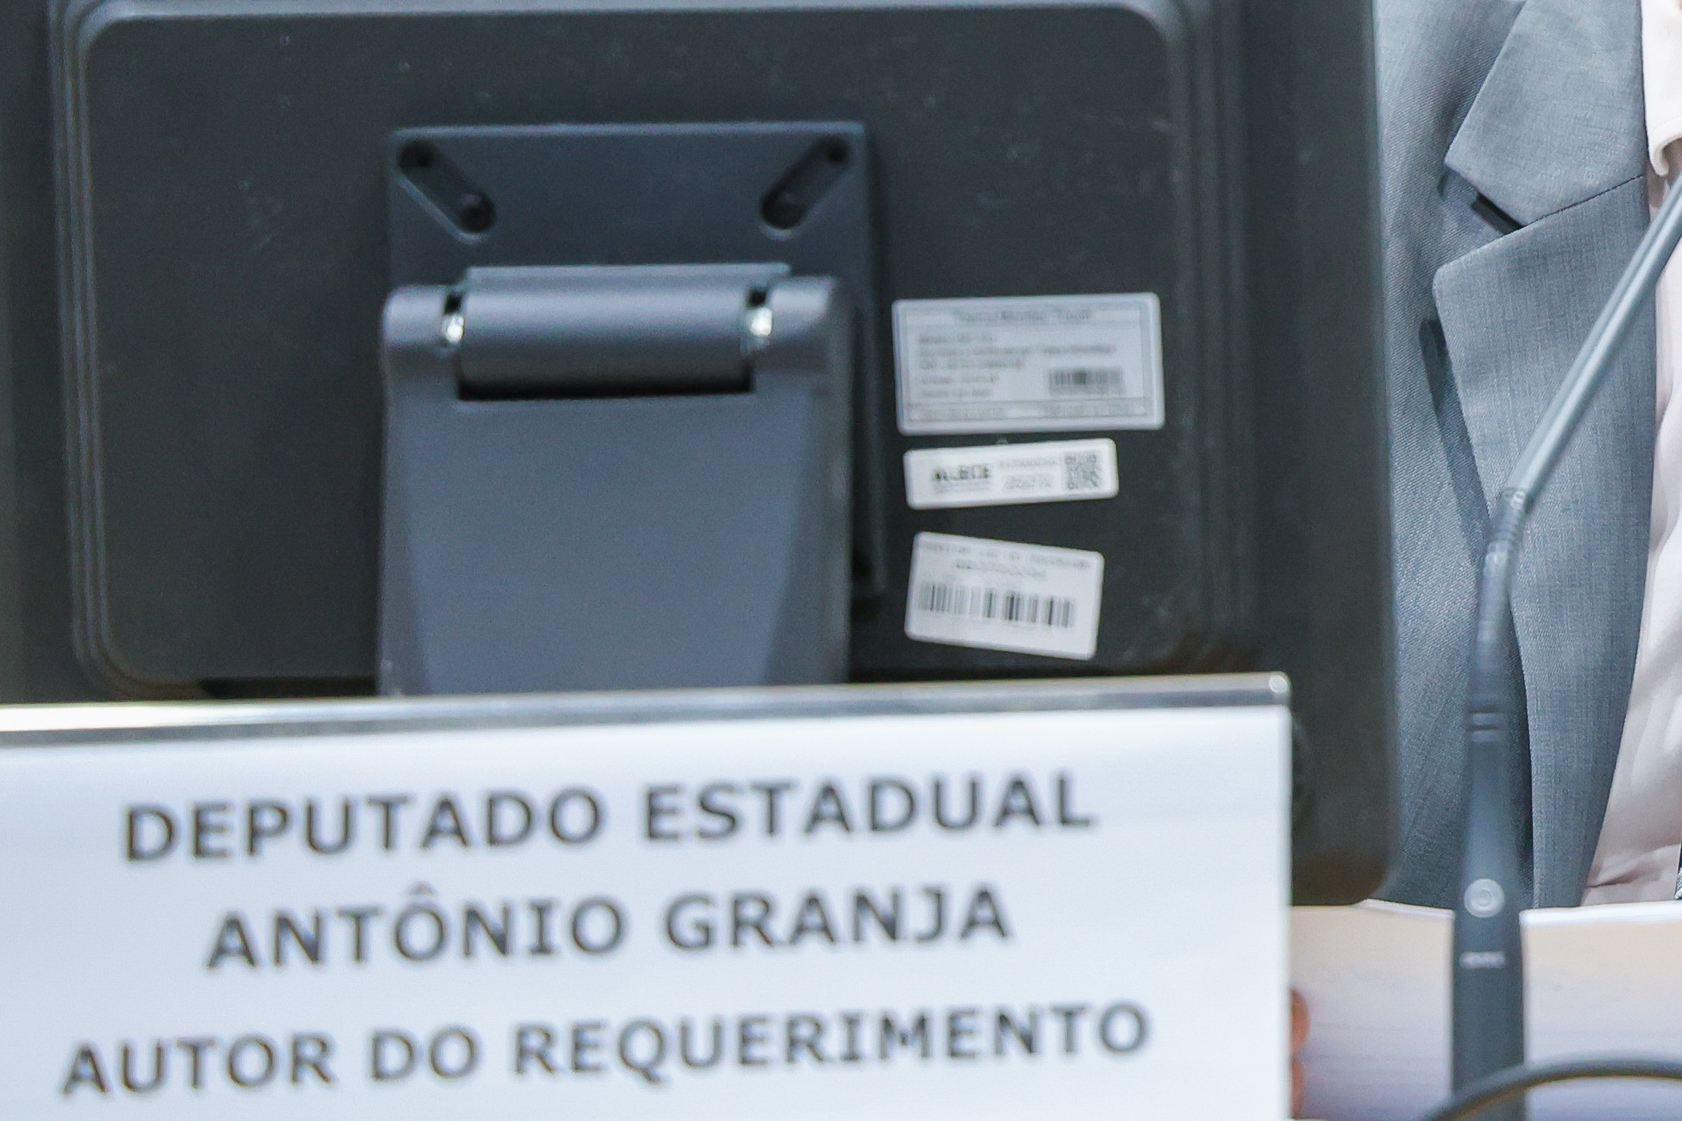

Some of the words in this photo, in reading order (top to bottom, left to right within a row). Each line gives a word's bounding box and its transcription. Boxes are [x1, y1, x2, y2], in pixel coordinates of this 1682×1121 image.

[123, 787, 606, 863] DEPUTADO
[643, 773, 1098, 843] ESTADUAL
[204, 884, 627, 971] ANTÔNIO
[662, 884, 1014, 954] GRANJA
[60, 1034, 335, 1097] AUTOR
[369, 1026, 480, 1083] DO
[514, 1001, 1150, 1085] REQUERIMENTO
